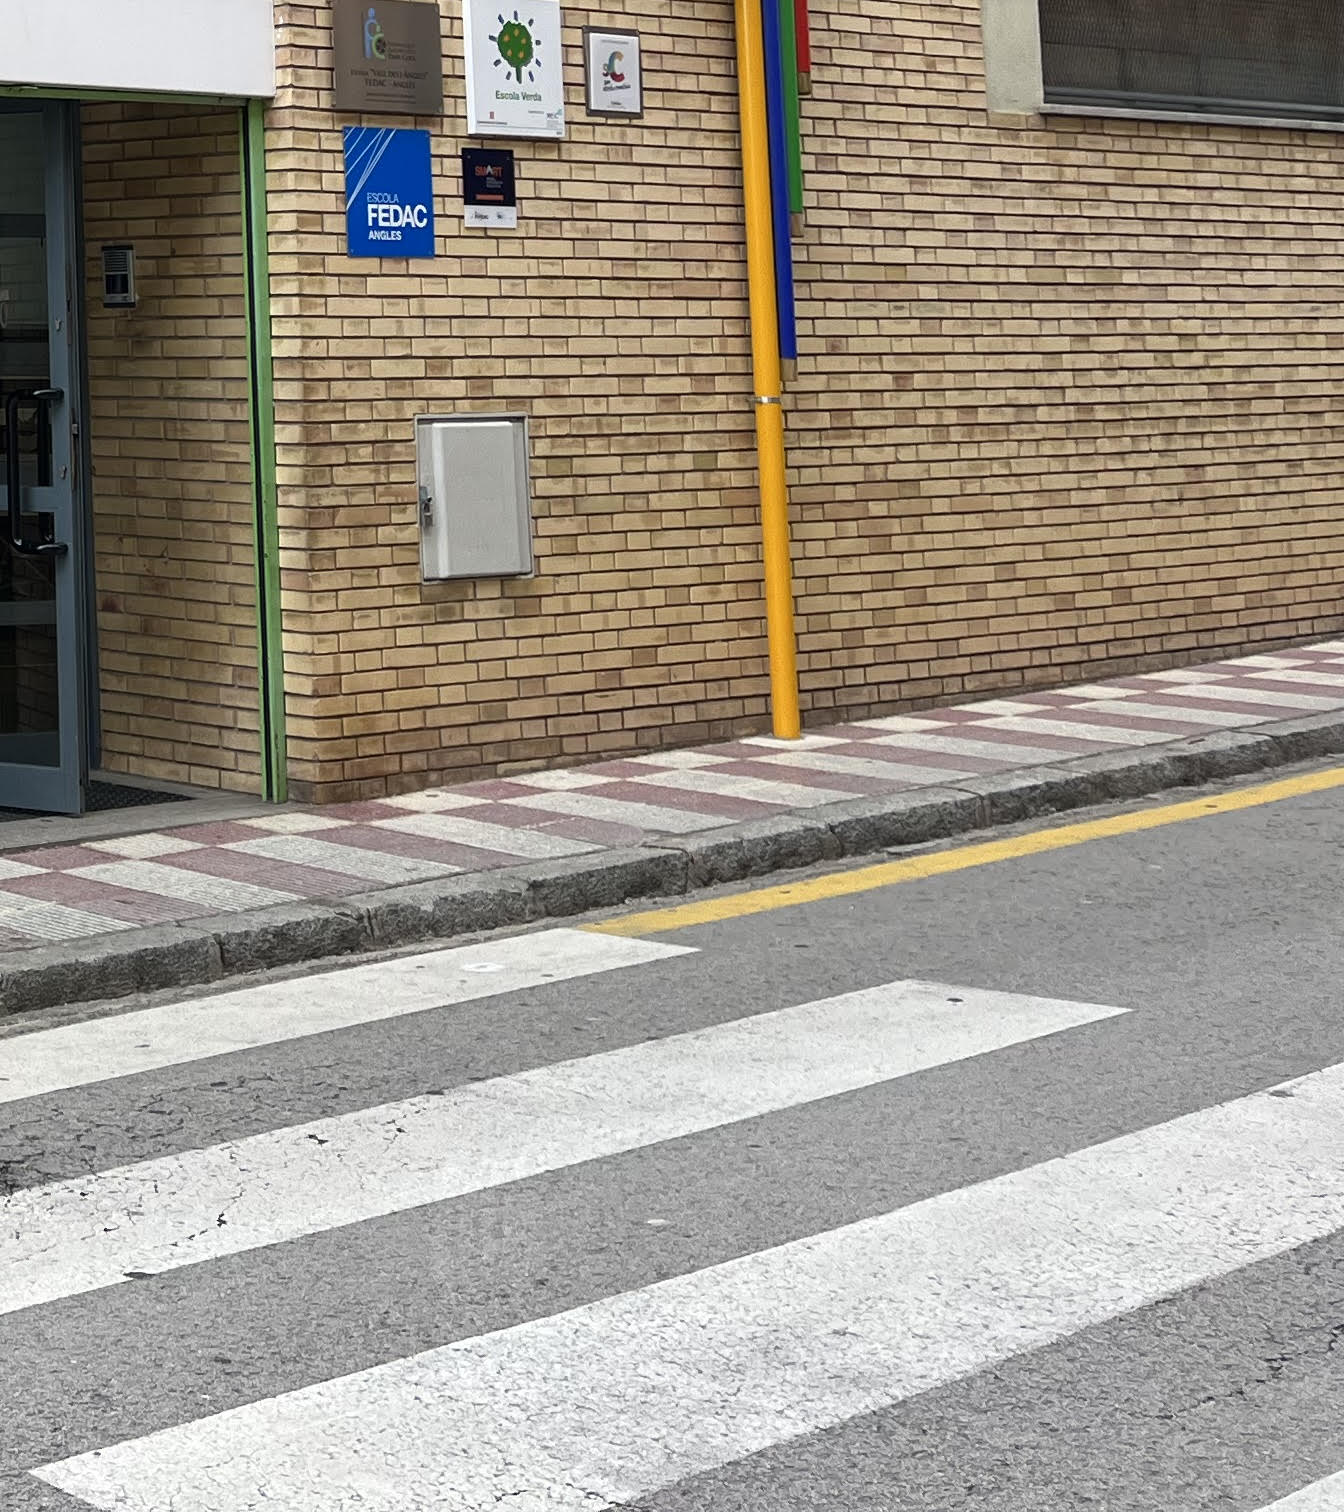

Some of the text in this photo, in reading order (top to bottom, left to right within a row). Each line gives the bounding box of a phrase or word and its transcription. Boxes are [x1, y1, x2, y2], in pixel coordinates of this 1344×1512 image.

[495, 90, 542, 102] Escola Verda
[474, 164, 504, 177] SMART
[366, 192, 400, 204] ESCOLA
[367, 203, 428, 228] FEDAC
